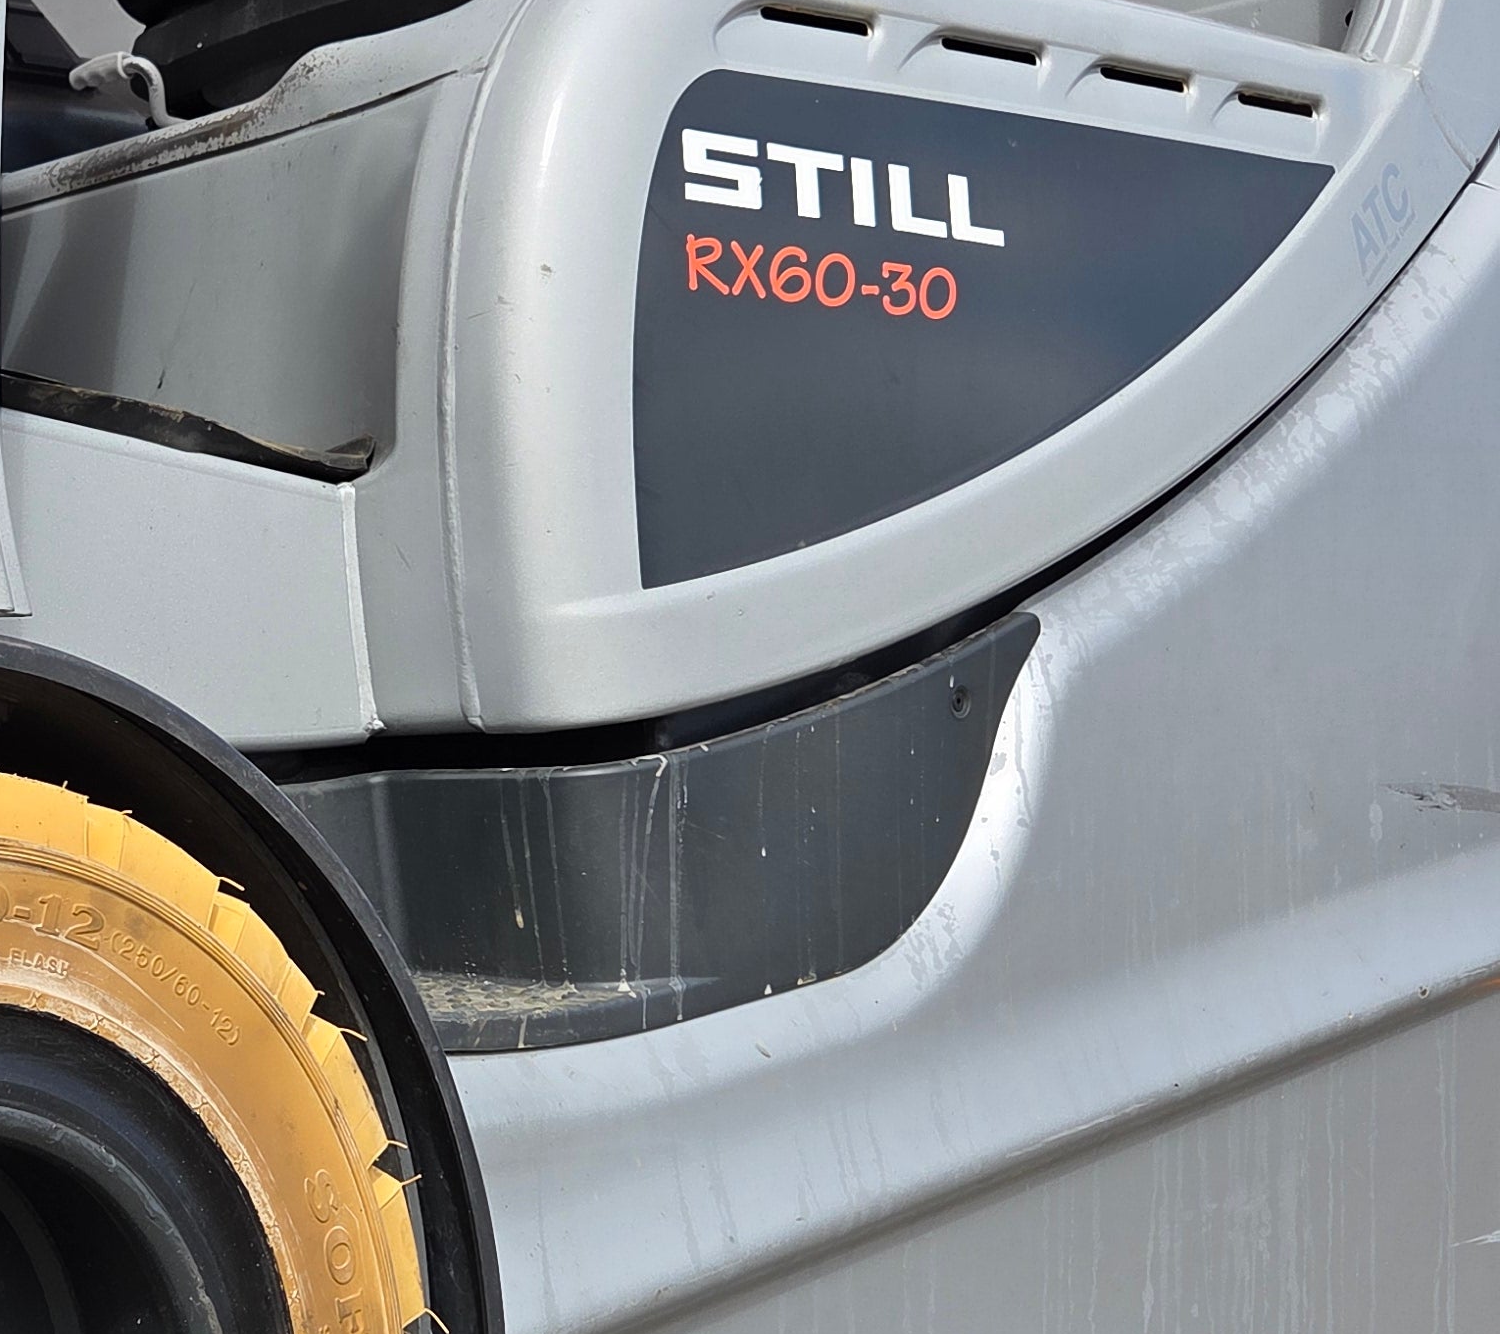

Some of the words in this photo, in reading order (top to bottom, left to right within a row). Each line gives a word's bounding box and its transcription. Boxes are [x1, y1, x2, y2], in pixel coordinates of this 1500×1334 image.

[681, 128, 1006, 248] STILL
[1350, 162, 1410, 279] ATC
[684, 233, 958, 321] RX60-30
[108, 930, 243, 1048] (250/60-12)
